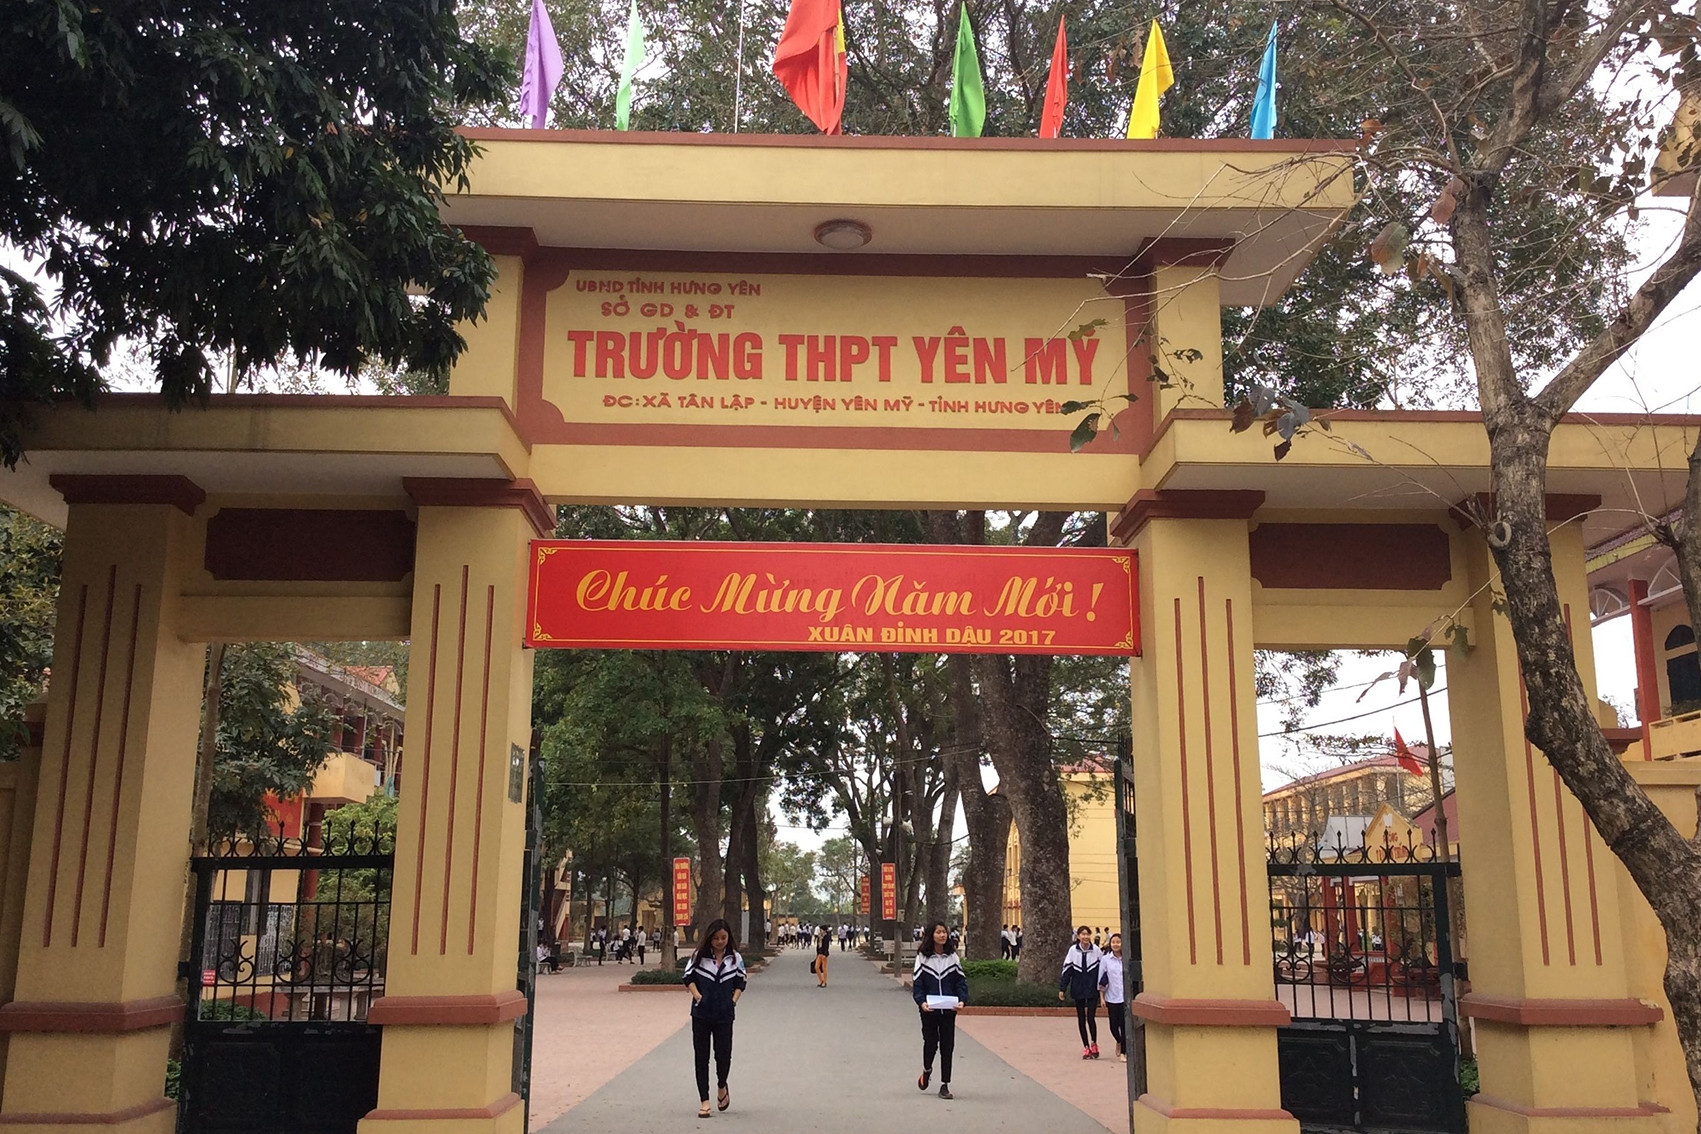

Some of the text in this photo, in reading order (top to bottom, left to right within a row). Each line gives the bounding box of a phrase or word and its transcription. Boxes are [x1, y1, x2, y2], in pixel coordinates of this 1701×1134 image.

[576, 277, 761, 297] UBND TỈNH HƯNG YÊN
[601, 295, 735, 320] SỞ GD & ĐT
[567, 320, 763, 380] TRƯỜNG
[778, 334, 898, 382] THPT
[912, 326, 1007, 384] YÊN
[677, 393, 714, 409] TÂN
[720, 394, 755, 411] LẬP
[774, 395, 836, 414] HUYỆN
[841, 395, 877, 411] YÊN
[883, 395, 914, 412] MỸ
[928, 395, 970, 413] TỈNH
[974, 401, 1029, 414] HƯNG
[575, 569, 693, 612] Chúc
[699, 572, 846, 623] Mừng
[851, 574, 977, 616] Năm
[807, 624, 874, 642] XUÂN
[999, 629, 1056, 645] 2017
